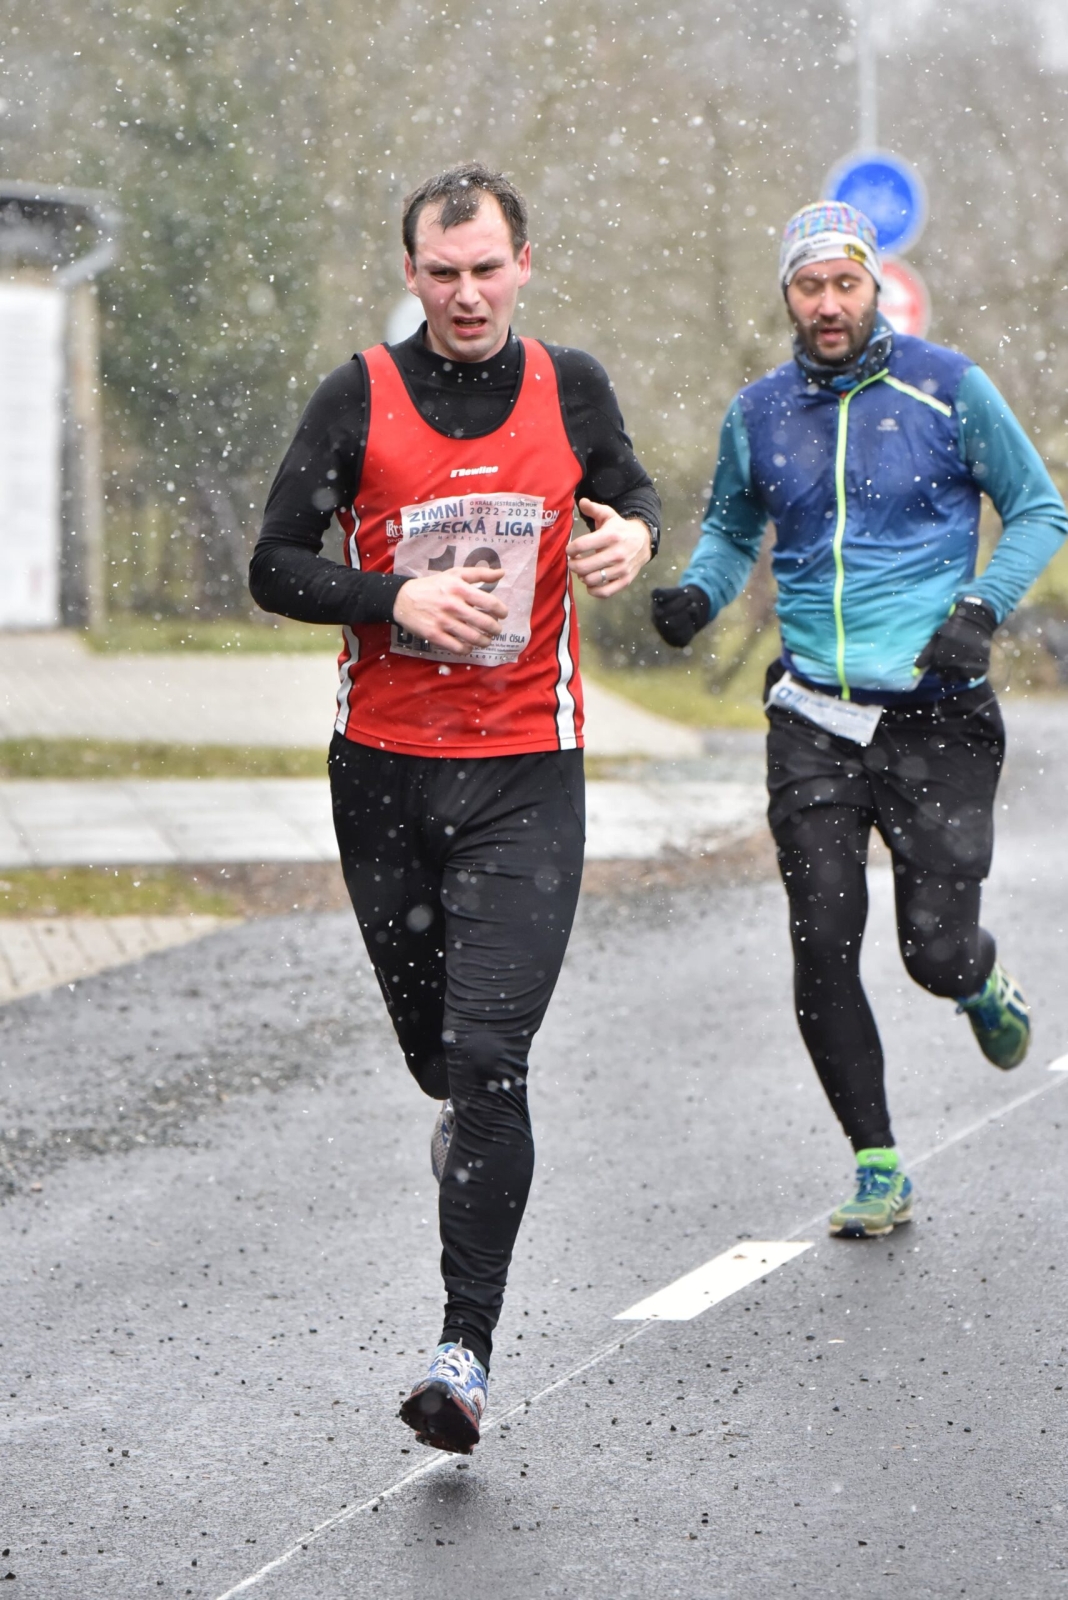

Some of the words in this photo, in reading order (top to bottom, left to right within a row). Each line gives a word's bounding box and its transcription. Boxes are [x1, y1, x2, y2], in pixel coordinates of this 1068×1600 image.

[409, 499, 464, 523] ZIMNÍ
[469, 507, 536, 517] 2022-2023
[495, 521, 534, 537] LIGA
[509, 633, 525, 644] ČÍSLA
